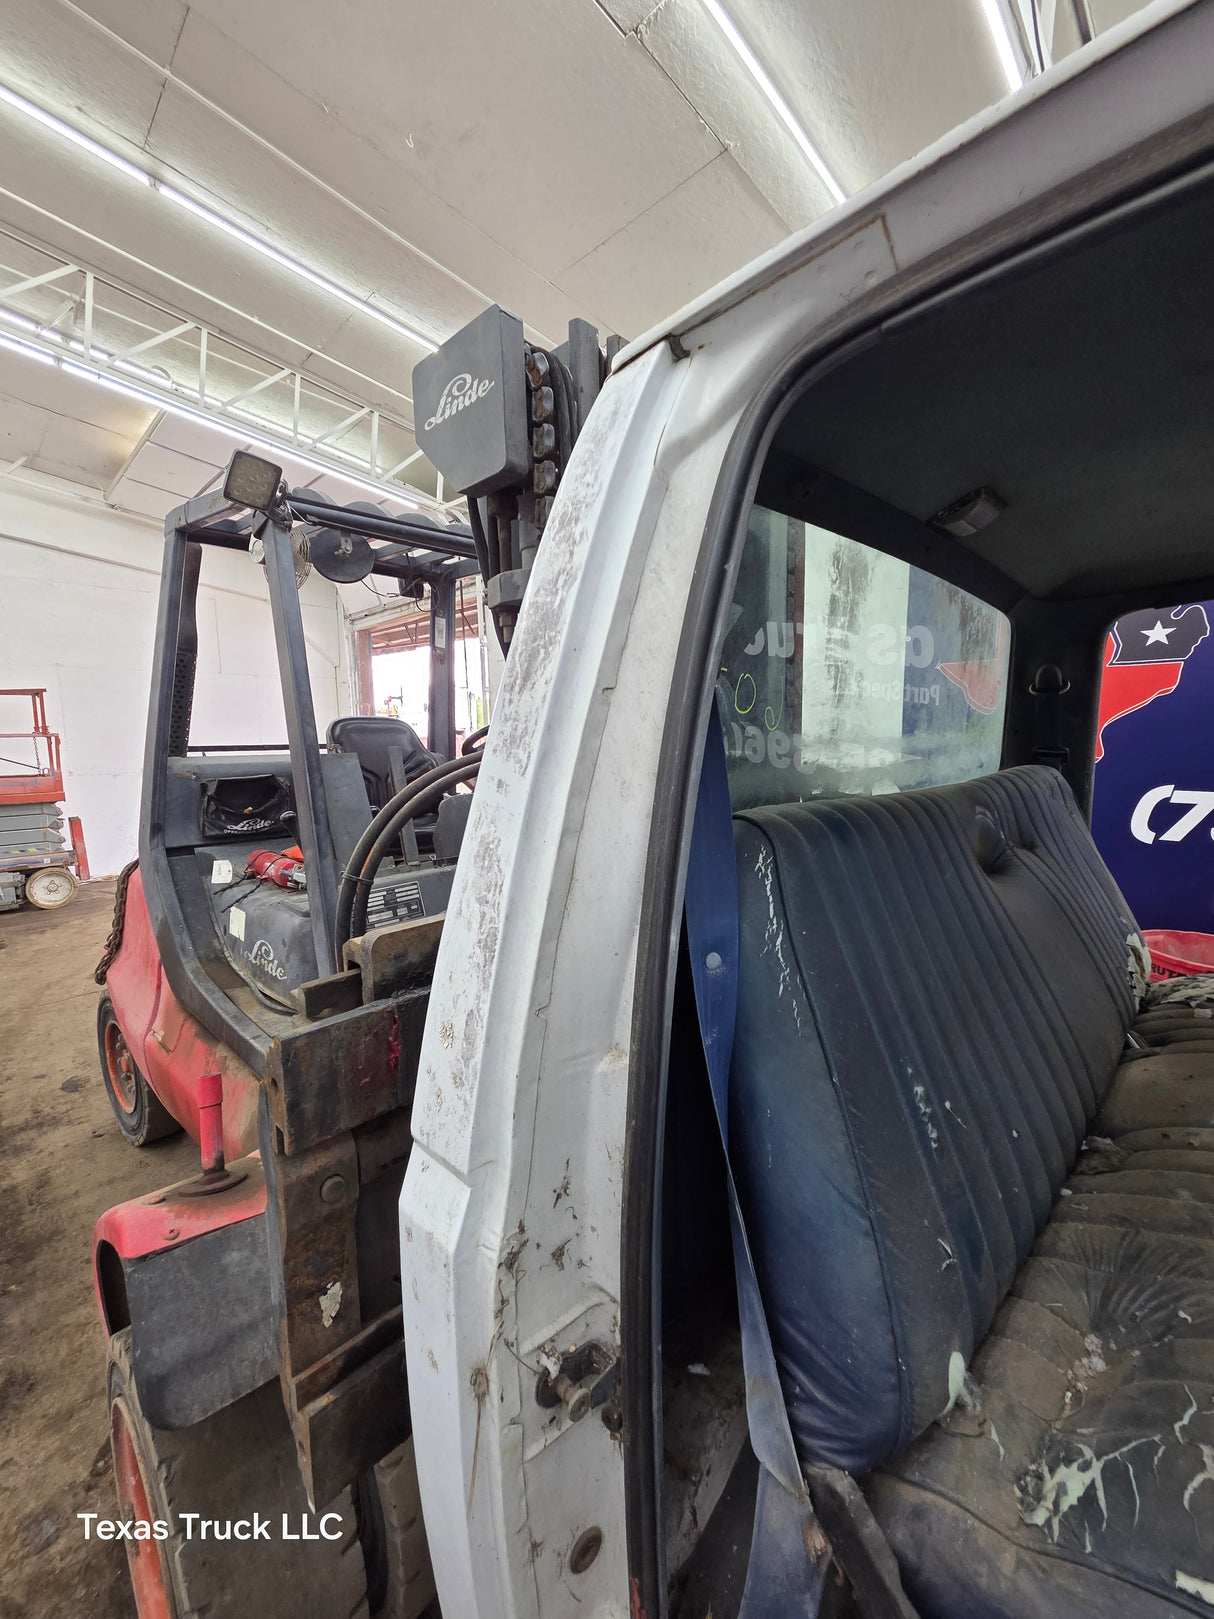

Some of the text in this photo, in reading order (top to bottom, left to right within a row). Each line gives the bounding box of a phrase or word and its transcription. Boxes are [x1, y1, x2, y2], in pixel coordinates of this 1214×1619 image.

[424, 373, 495, 431] Linde
[226, 817, 275, 831] Linde
[244, 939, 288, 980] Linde
